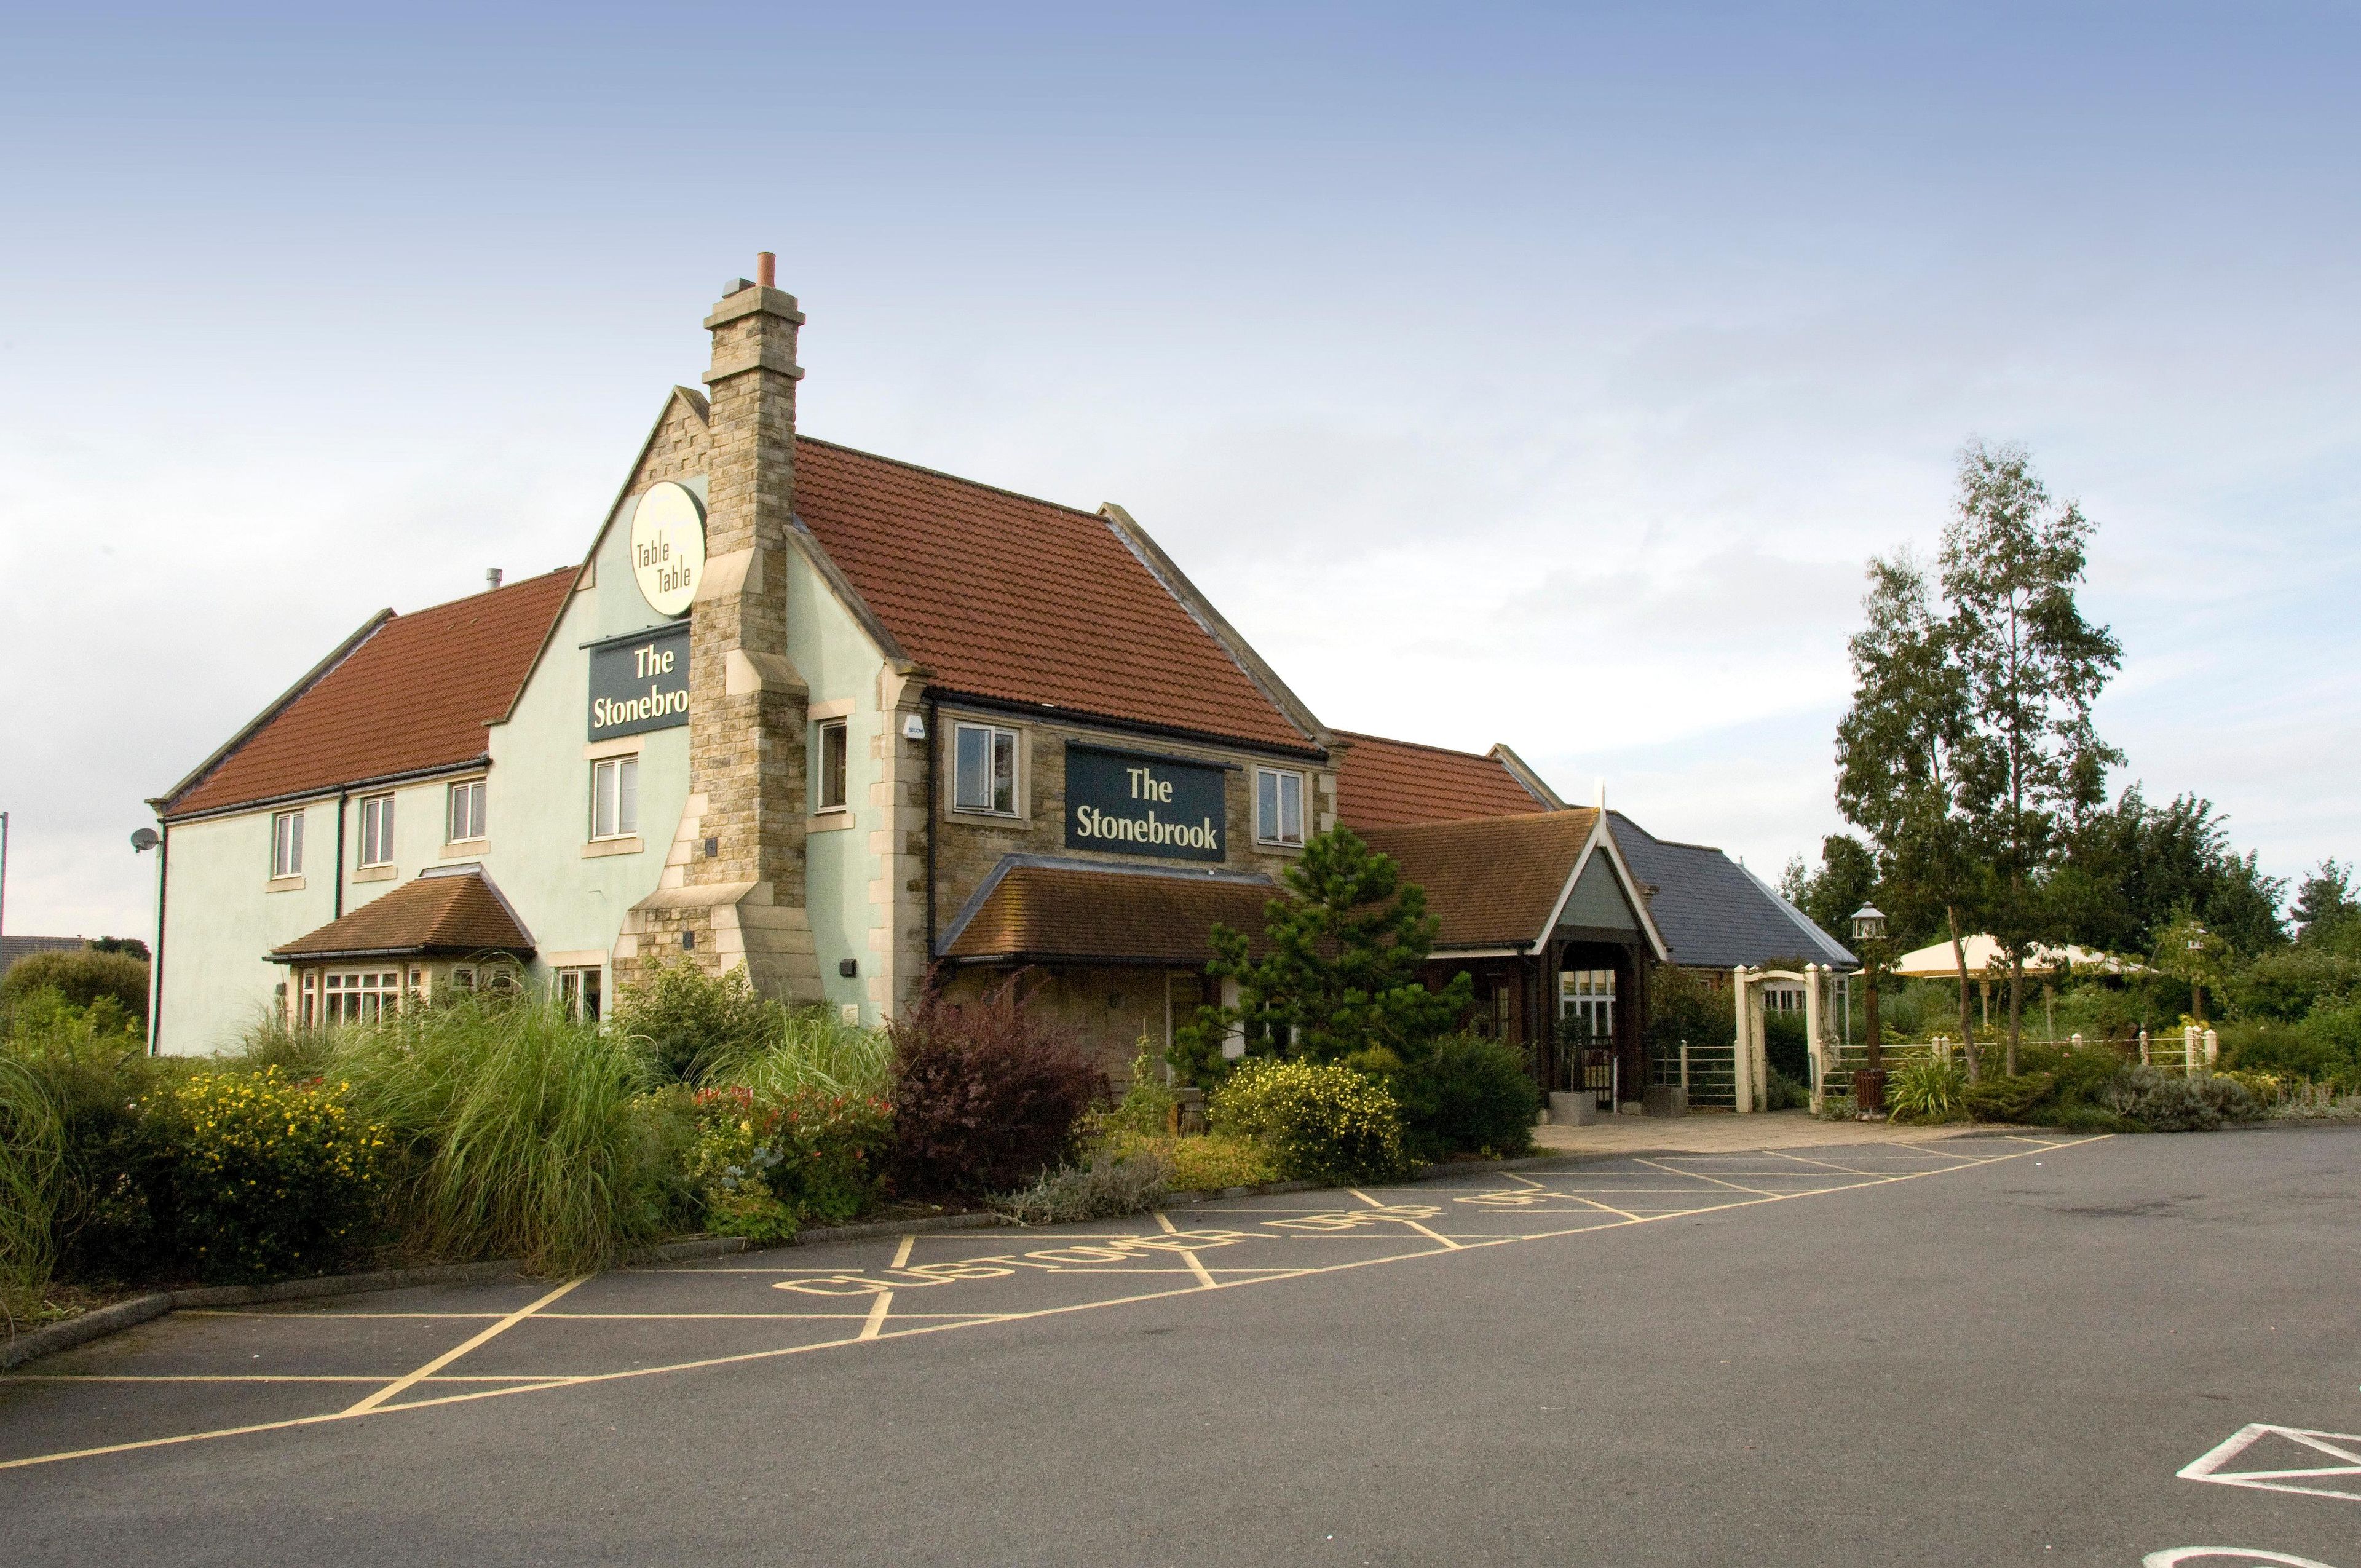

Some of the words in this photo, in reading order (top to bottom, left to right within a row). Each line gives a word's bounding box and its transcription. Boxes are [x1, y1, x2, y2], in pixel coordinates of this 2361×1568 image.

[637, 530, 669, 568] Table
[658, 555, 690, 593] Table
[635, 644, 674, 678] The
[594, 685, 689, 728] Stonebro
[1126, 768, 1173, 802] The
[1077, 805, 1217, 850] Stonebrook
[772, 1230, 1281, 1296] CUSTOMER
[1260, 1205, 1447, 1231] DROP
